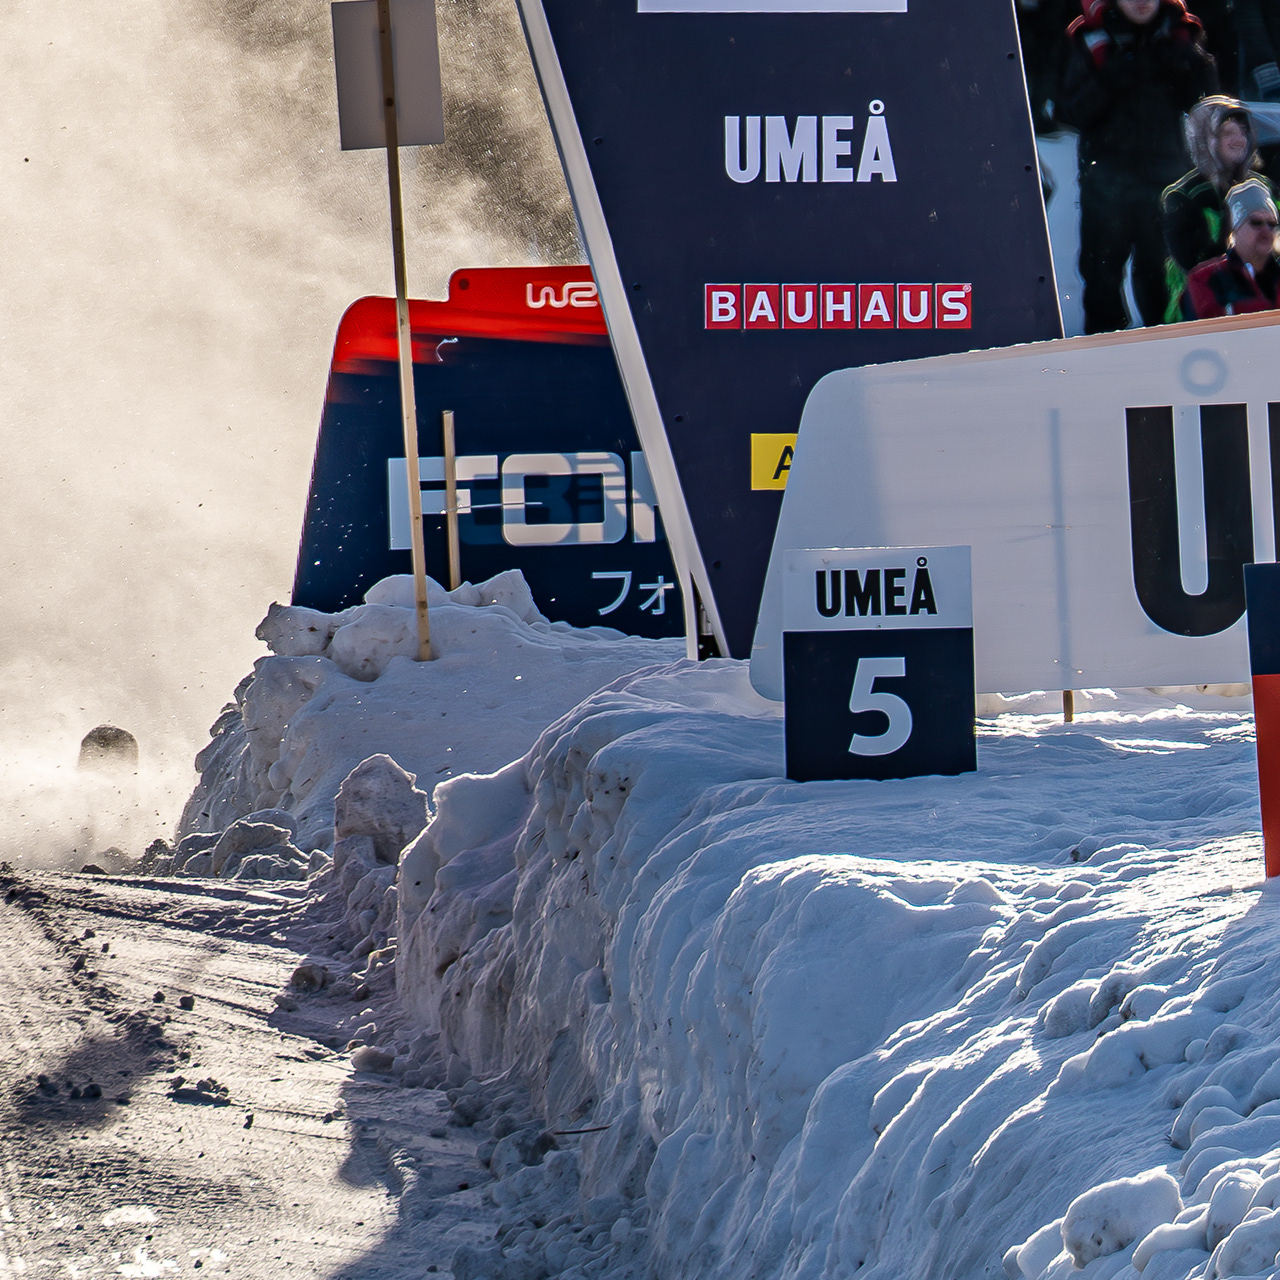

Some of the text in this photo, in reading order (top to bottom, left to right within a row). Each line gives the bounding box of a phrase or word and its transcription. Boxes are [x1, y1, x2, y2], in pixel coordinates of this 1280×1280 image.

[724, 99, 898, 184] UMEÅ
[526, 281, 599, 309] WR
[711, 290, 969, 323] BAUHAUS
[815, 557, 938, 618] UMEÅ
[848, 657, 913, 757] 5
